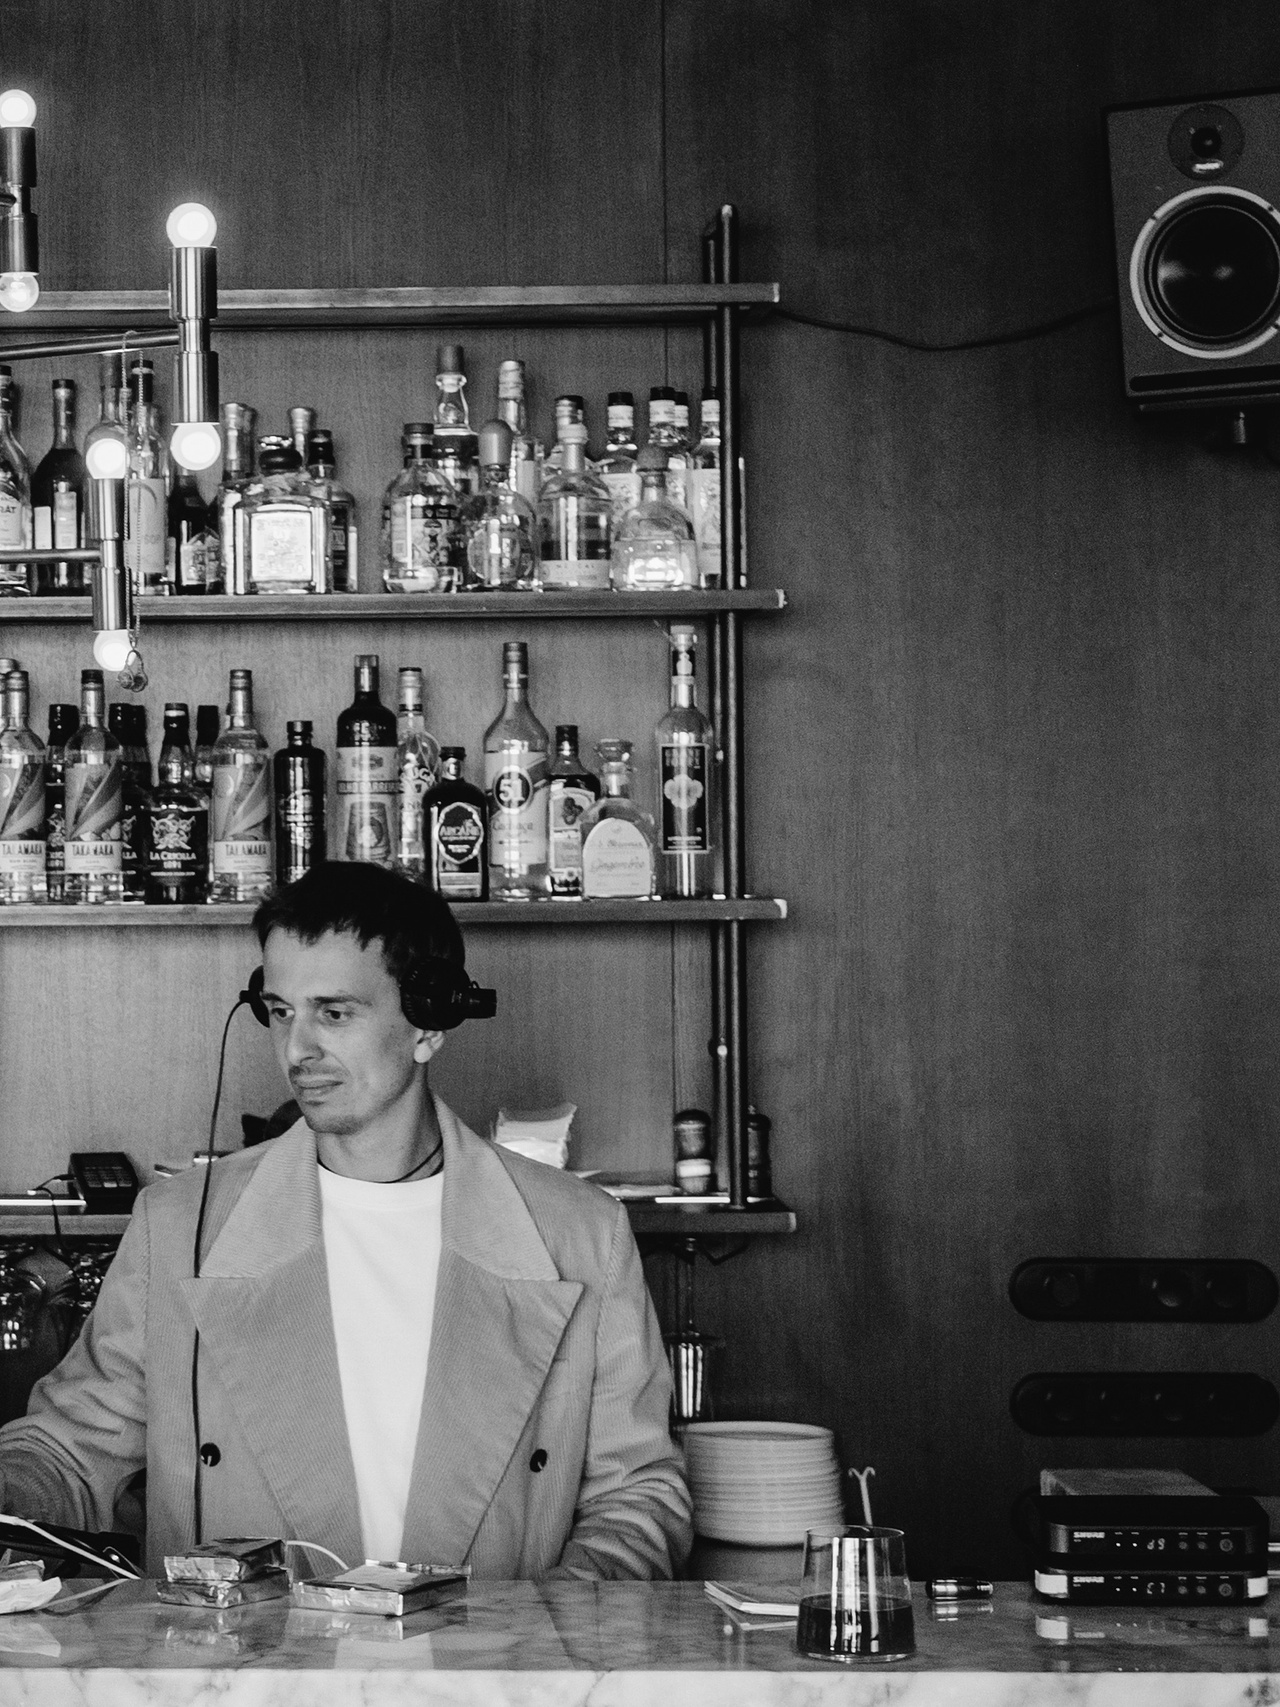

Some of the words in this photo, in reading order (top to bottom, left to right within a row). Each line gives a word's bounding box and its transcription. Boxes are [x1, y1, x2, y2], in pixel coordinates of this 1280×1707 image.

[499, 778, 525, 802] 51
[2, 843, 42, 856] TAAMAKA
[149, 851, 161, 861] LA
